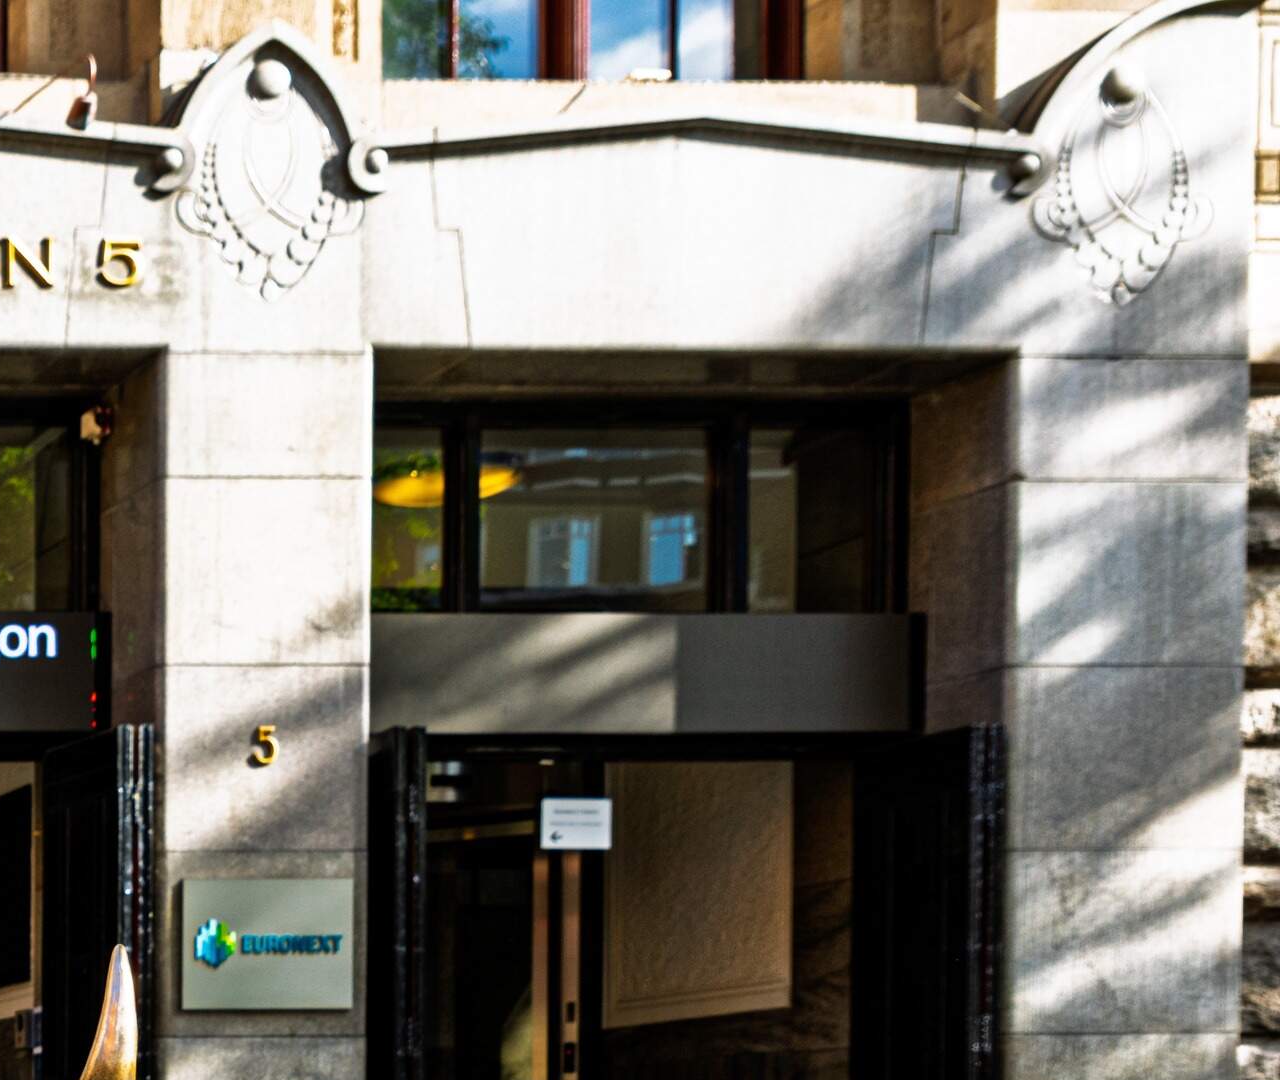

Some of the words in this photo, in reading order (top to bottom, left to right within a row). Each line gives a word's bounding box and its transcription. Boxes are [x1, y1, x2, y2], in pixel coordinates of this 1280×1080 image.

[95, 237, 143, 288] 5
[248, 725, 280, 766] 5
[240, 933, 344, 955] EURONEXT
